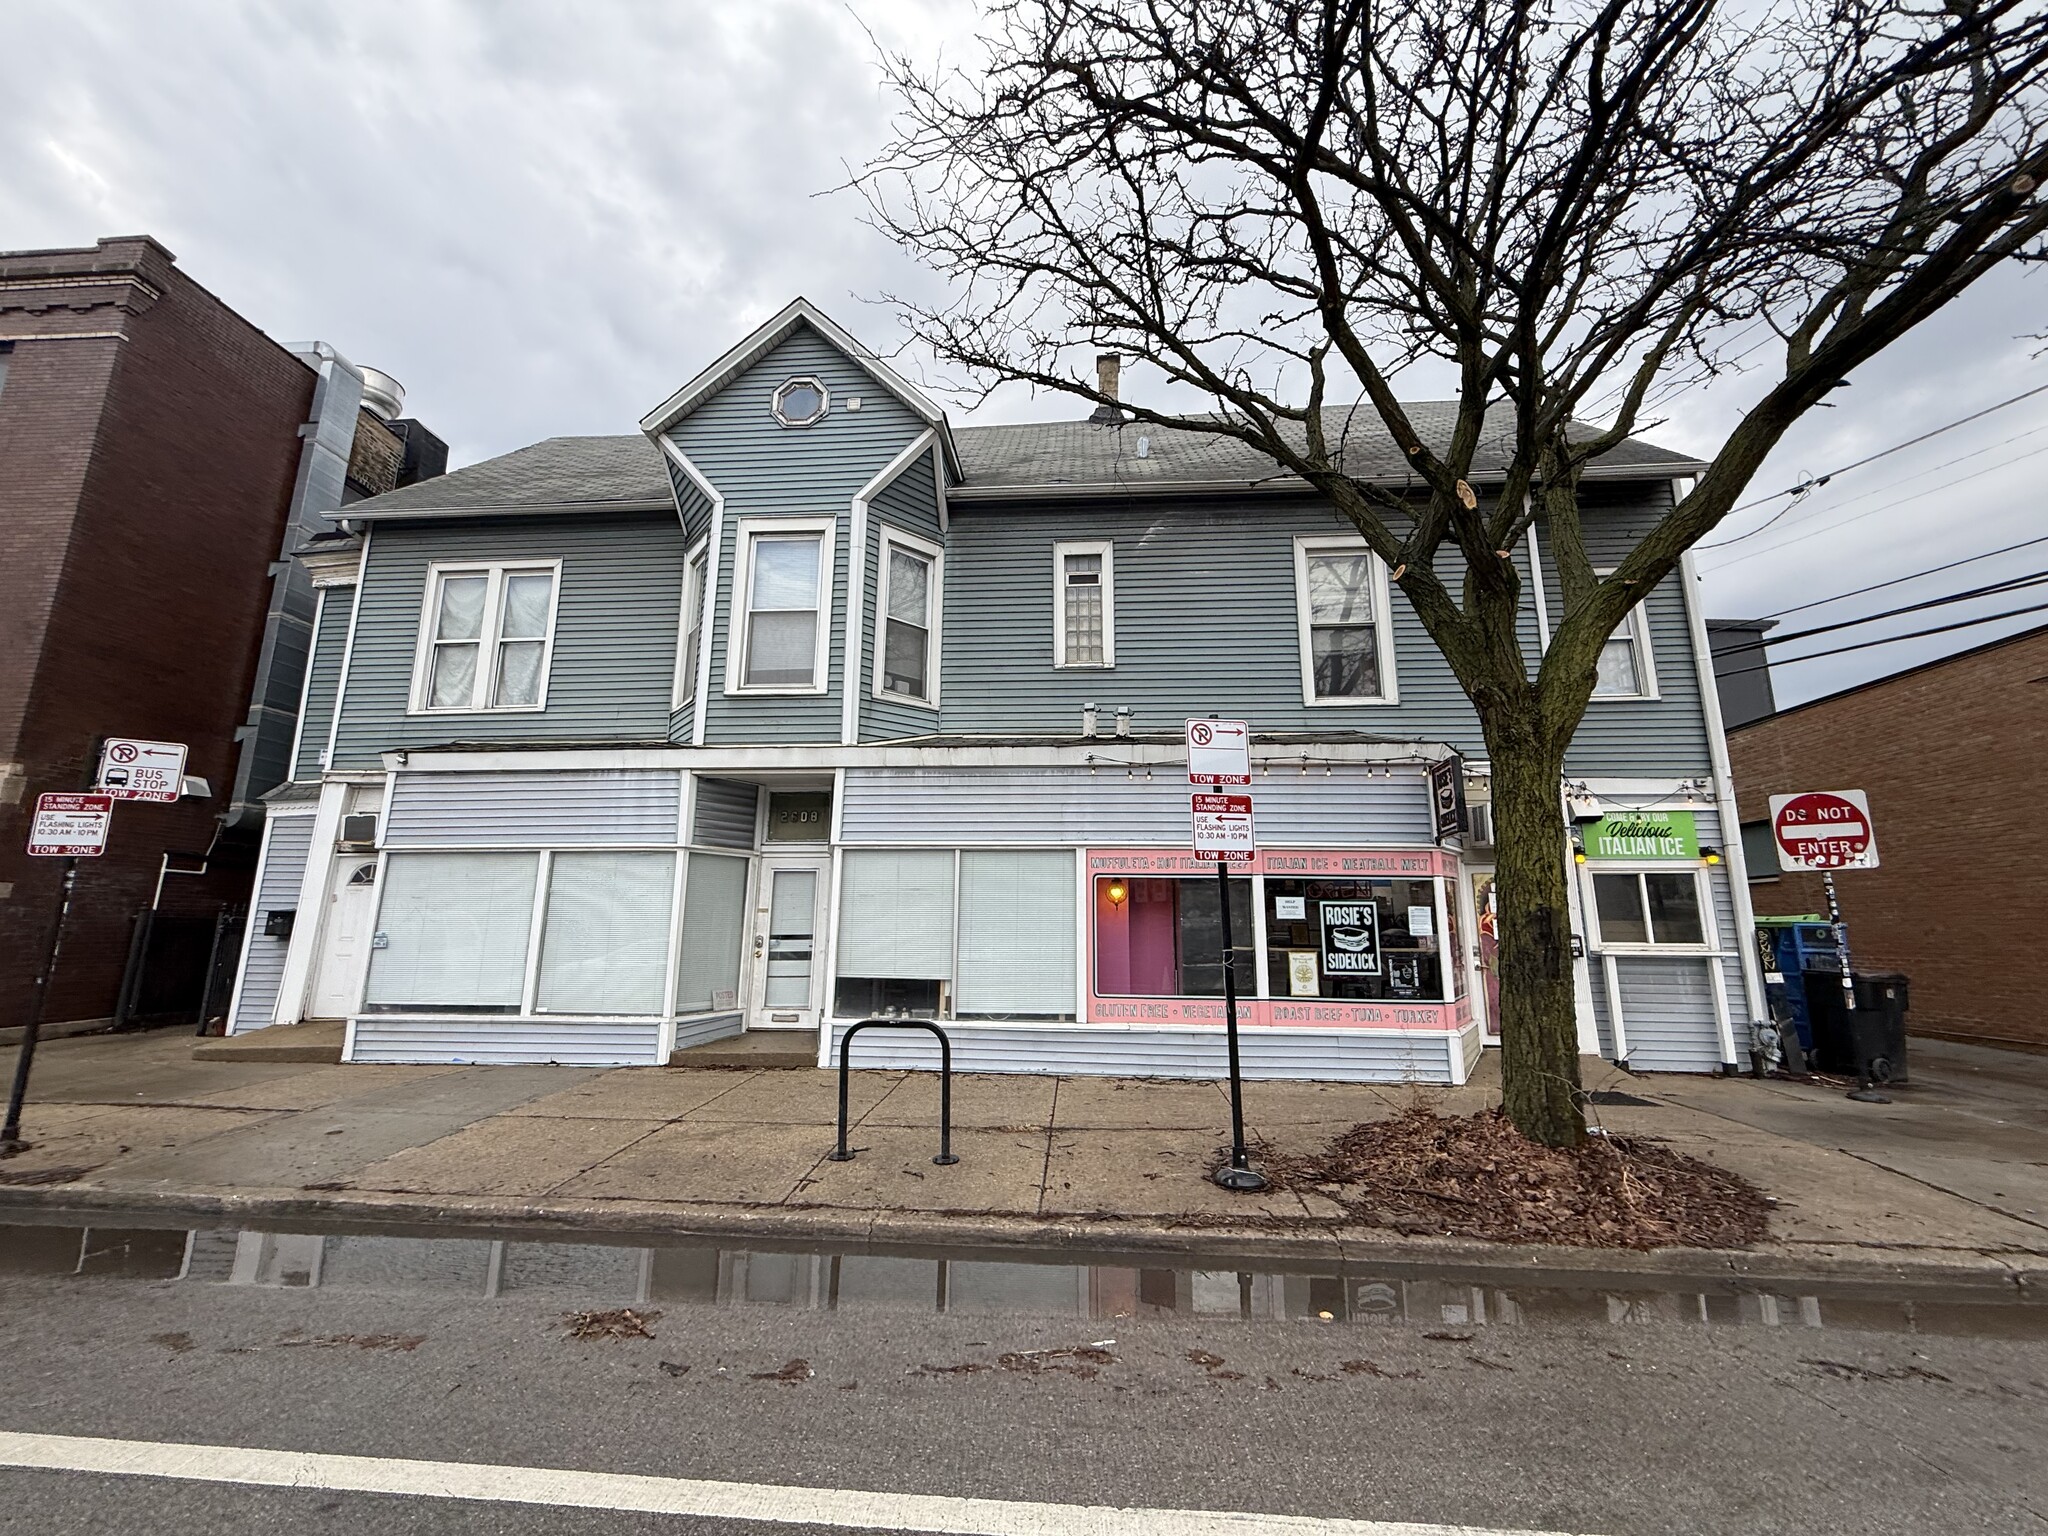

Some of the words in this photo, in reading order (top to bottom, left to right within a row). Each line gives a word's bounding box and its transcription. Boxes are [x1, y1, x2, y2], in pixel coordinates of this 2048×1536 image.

[135, 769, 163, 779] BUS
[1193, 775, 1214, 783] TOW
[1219, 775, 1246, 784] ZONE
[133, 779, 168, 789] STOP
[103, 789, 129, 797] TOW
[137, 791, 170, 800] ZONE
[780, 811, 818, 822] 2608
[1606, 813, 1628, 822] COME
[1636, 813, 1650, 822] RY
[1652, 813, 1668, 822] OUR
[1785, 809, 1807, 821] DO
[1817, 807, 1851, 819] NOT
[1606, 821, 1672, 838] Delicious
[65, 846, 97, 854] ZONE
[1599, 837, 1657, 855] ITALIAN
[1660, 837, 1685, 855] ICE
[1798, 841, 1854, 855] ENTER
[1198, 851, 1219, 860] TOW
[1223, 851, 1250, 860] ZONE
[1157, 857, 1176, 869] HOT
[1267, 857, 1307, 870] ITALIAN
[1311, 858, 1328, 870] ICE
[1342, 858, 1397, 870] MEATBALL
[1401, 859, 1429, 871] MELT
[1326, 906, 1372, 926] ROSIE'S
[1328, 953, 1376, 970] SIDEKICK
[1095, 1004, 1137, 1017] GLUTEN
[1140, 1004, 1168, 1018] FREE
[1182, 1005, 1251, 1018] VEGETAAN
[1274, 1007, 1310, 1020] ROAST
[1315, 1007, 1343, 1021] BEEF
[1351, 1008, 1382, 1022] TUNA
[1393, 1009, 1439, 1024] TURKEY
